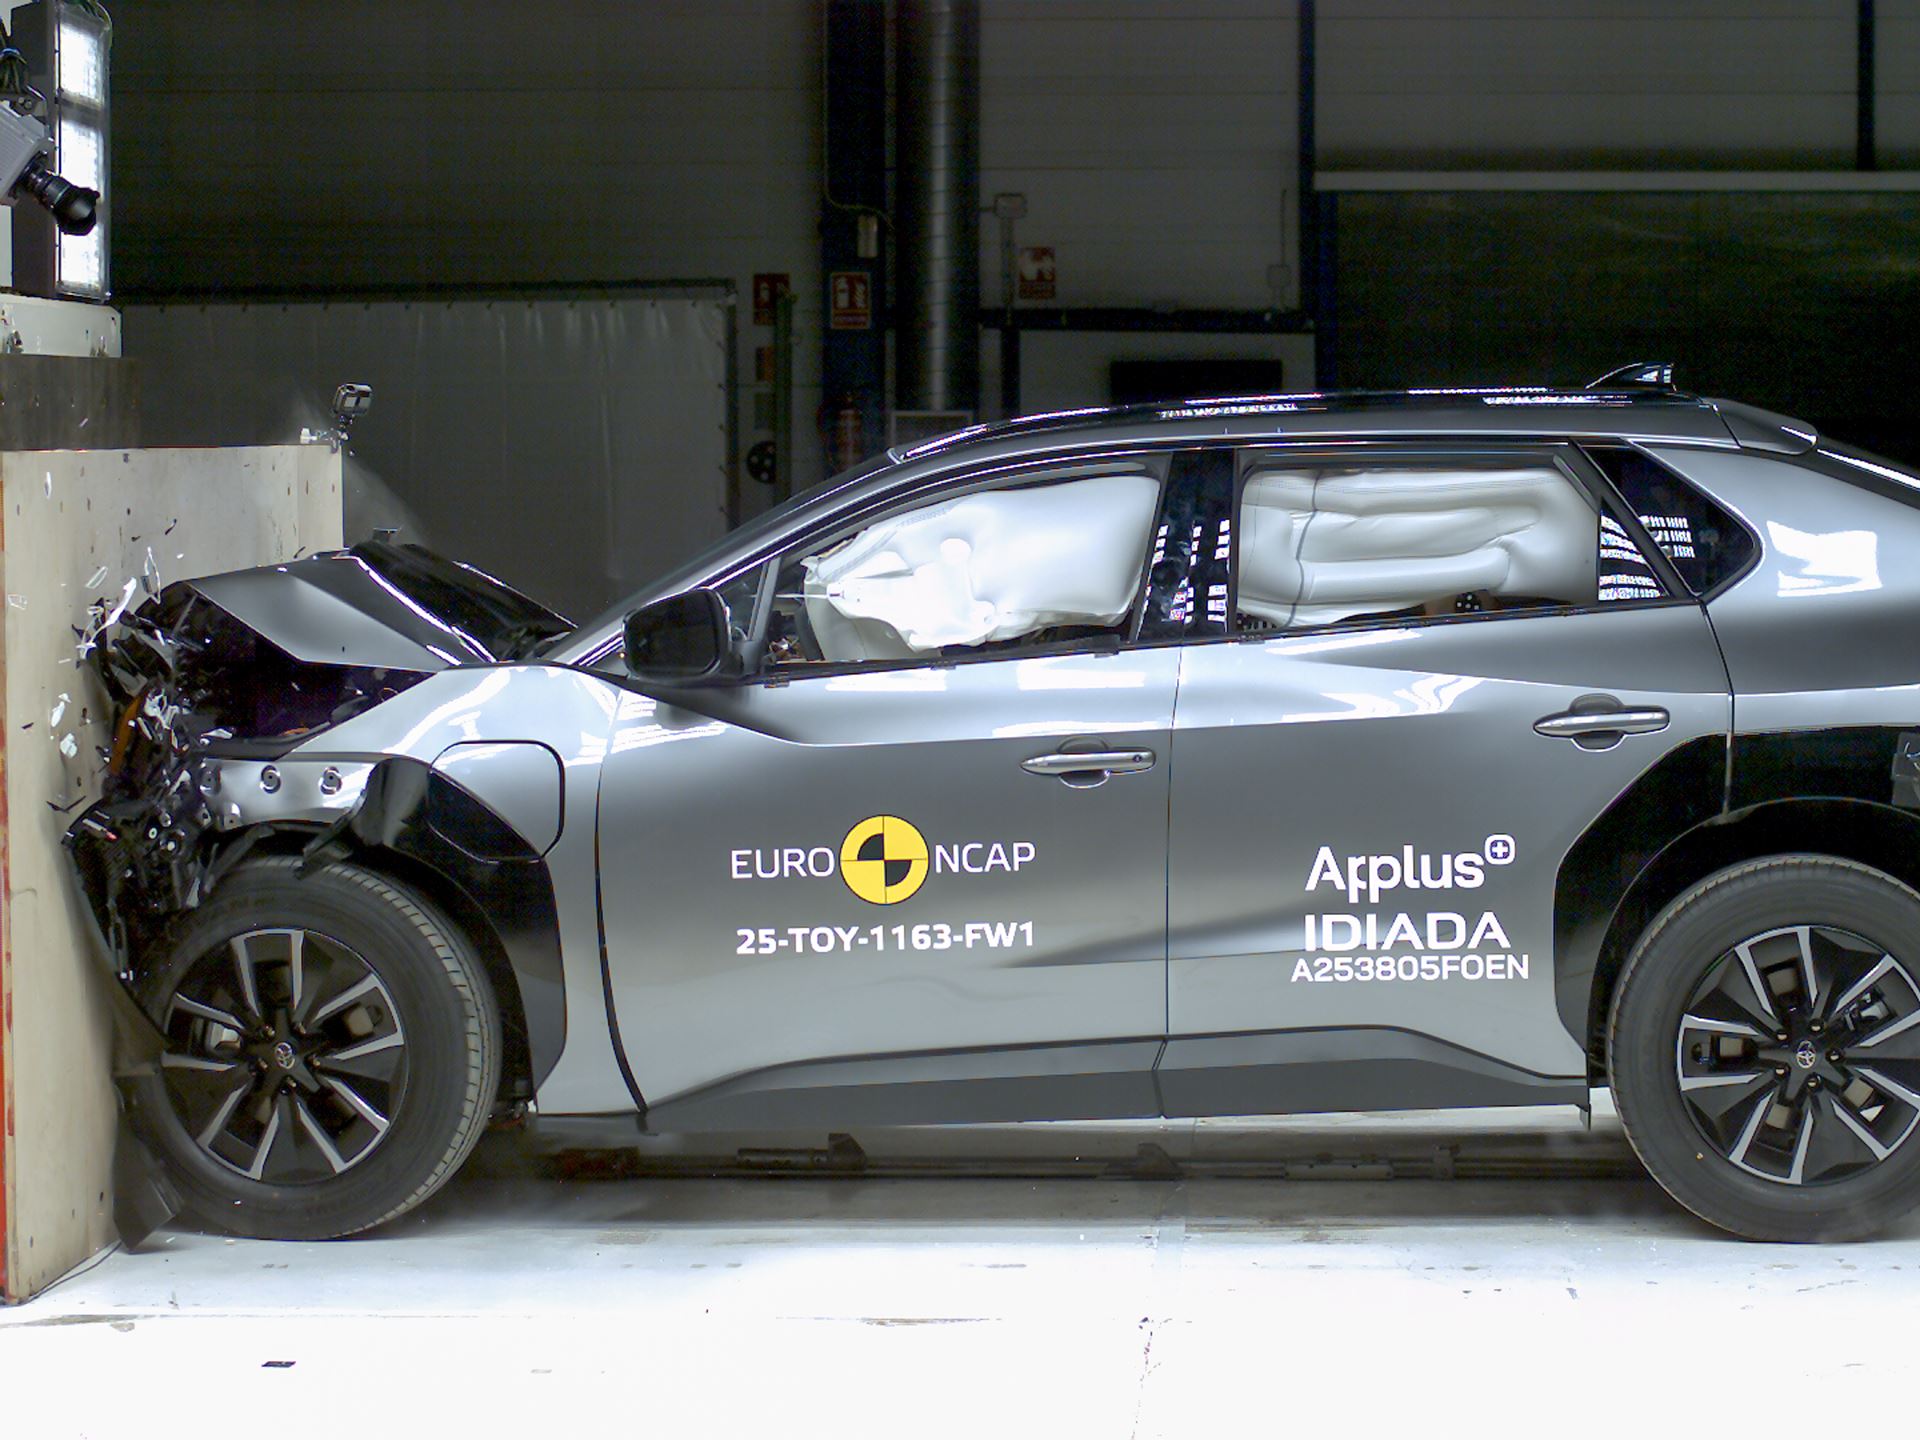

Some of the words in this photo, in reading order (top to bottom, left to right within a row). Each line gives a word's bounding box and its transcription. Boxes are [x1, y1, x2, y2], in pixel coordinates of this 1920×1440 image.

[731, 847, 836, 879] EURO
[934, 841, 1036, 874] NCAP
[736, 920, 1034, 955] 25-TOY-1163-FW1
[1304, 911, 1512, 952] IDIADA
